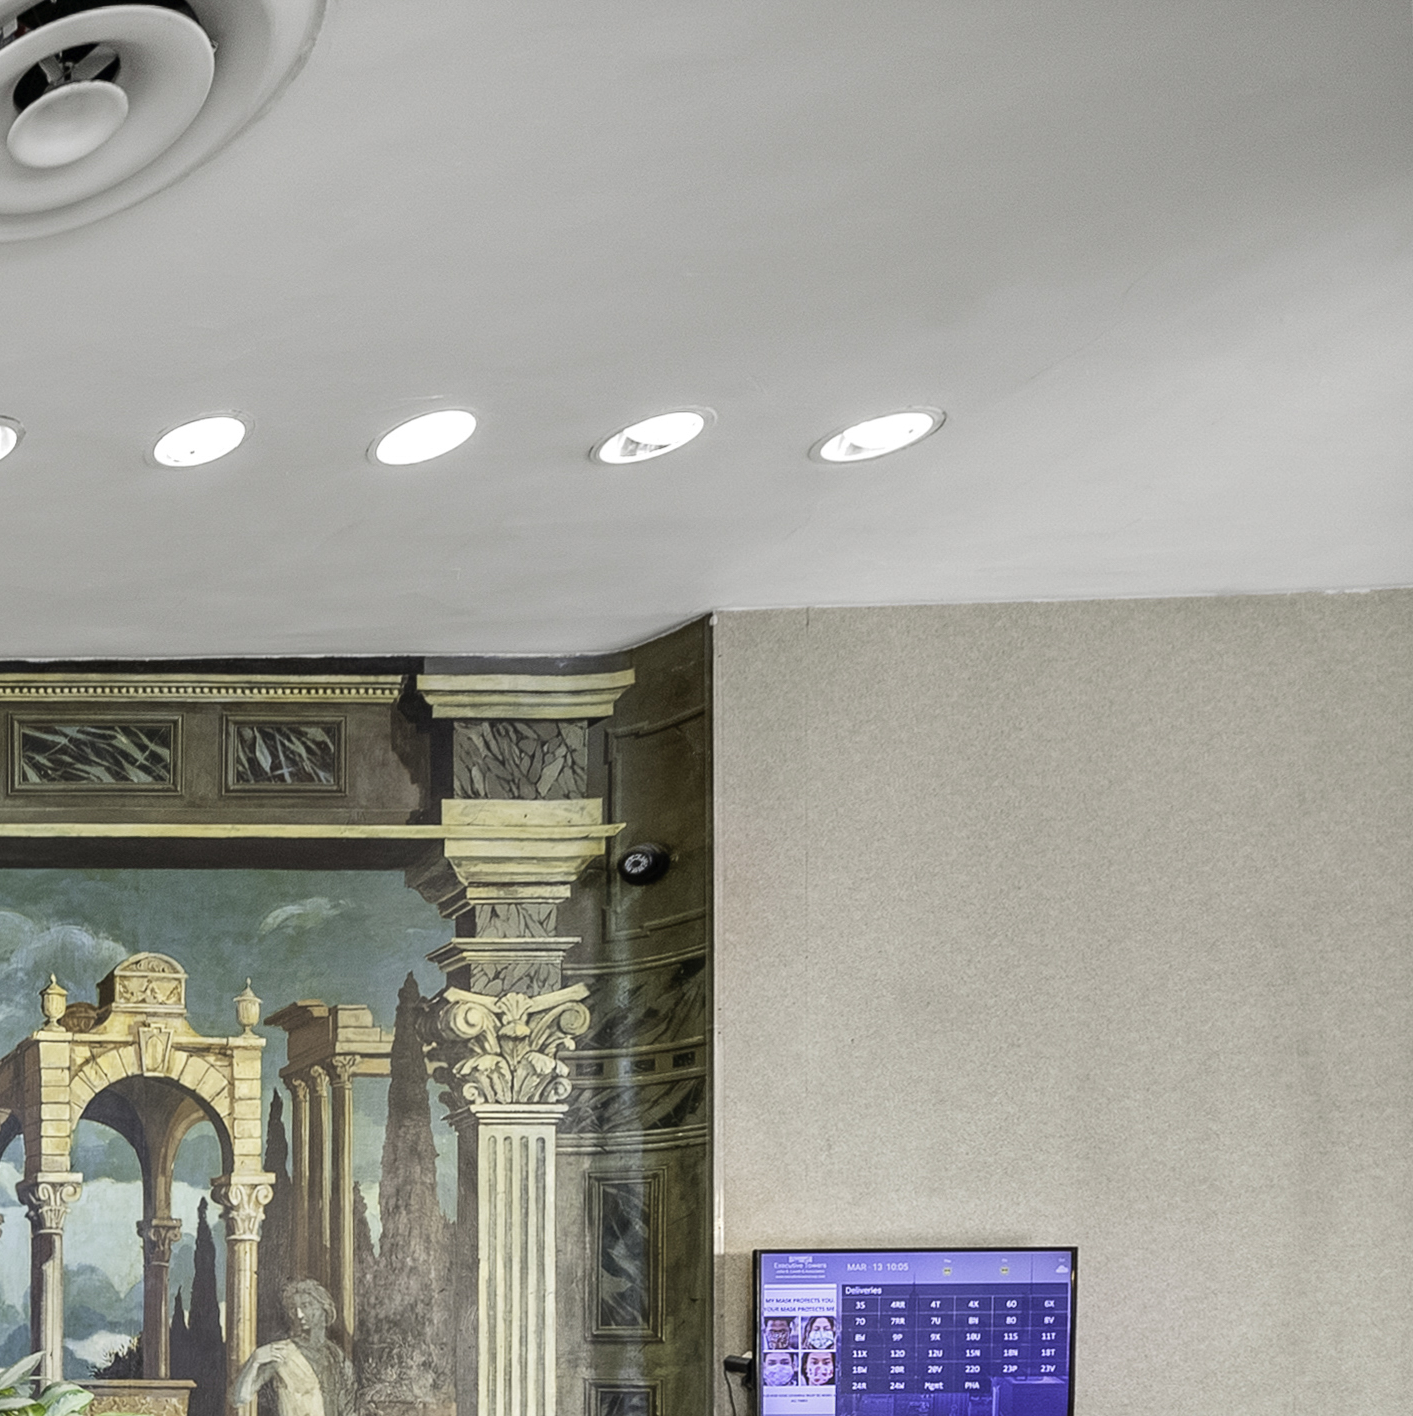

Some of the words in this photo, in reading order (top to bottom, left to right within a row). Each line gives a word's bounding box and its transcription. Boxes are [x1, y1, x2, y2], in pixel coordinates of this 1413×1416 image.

[847, 1263, 867, 1271] MAR
[873, 1263, 883, 1271] 13
[886, 1262, 909, 1271] 10:05
[845, 1286, 883, 1295] Deliveries
